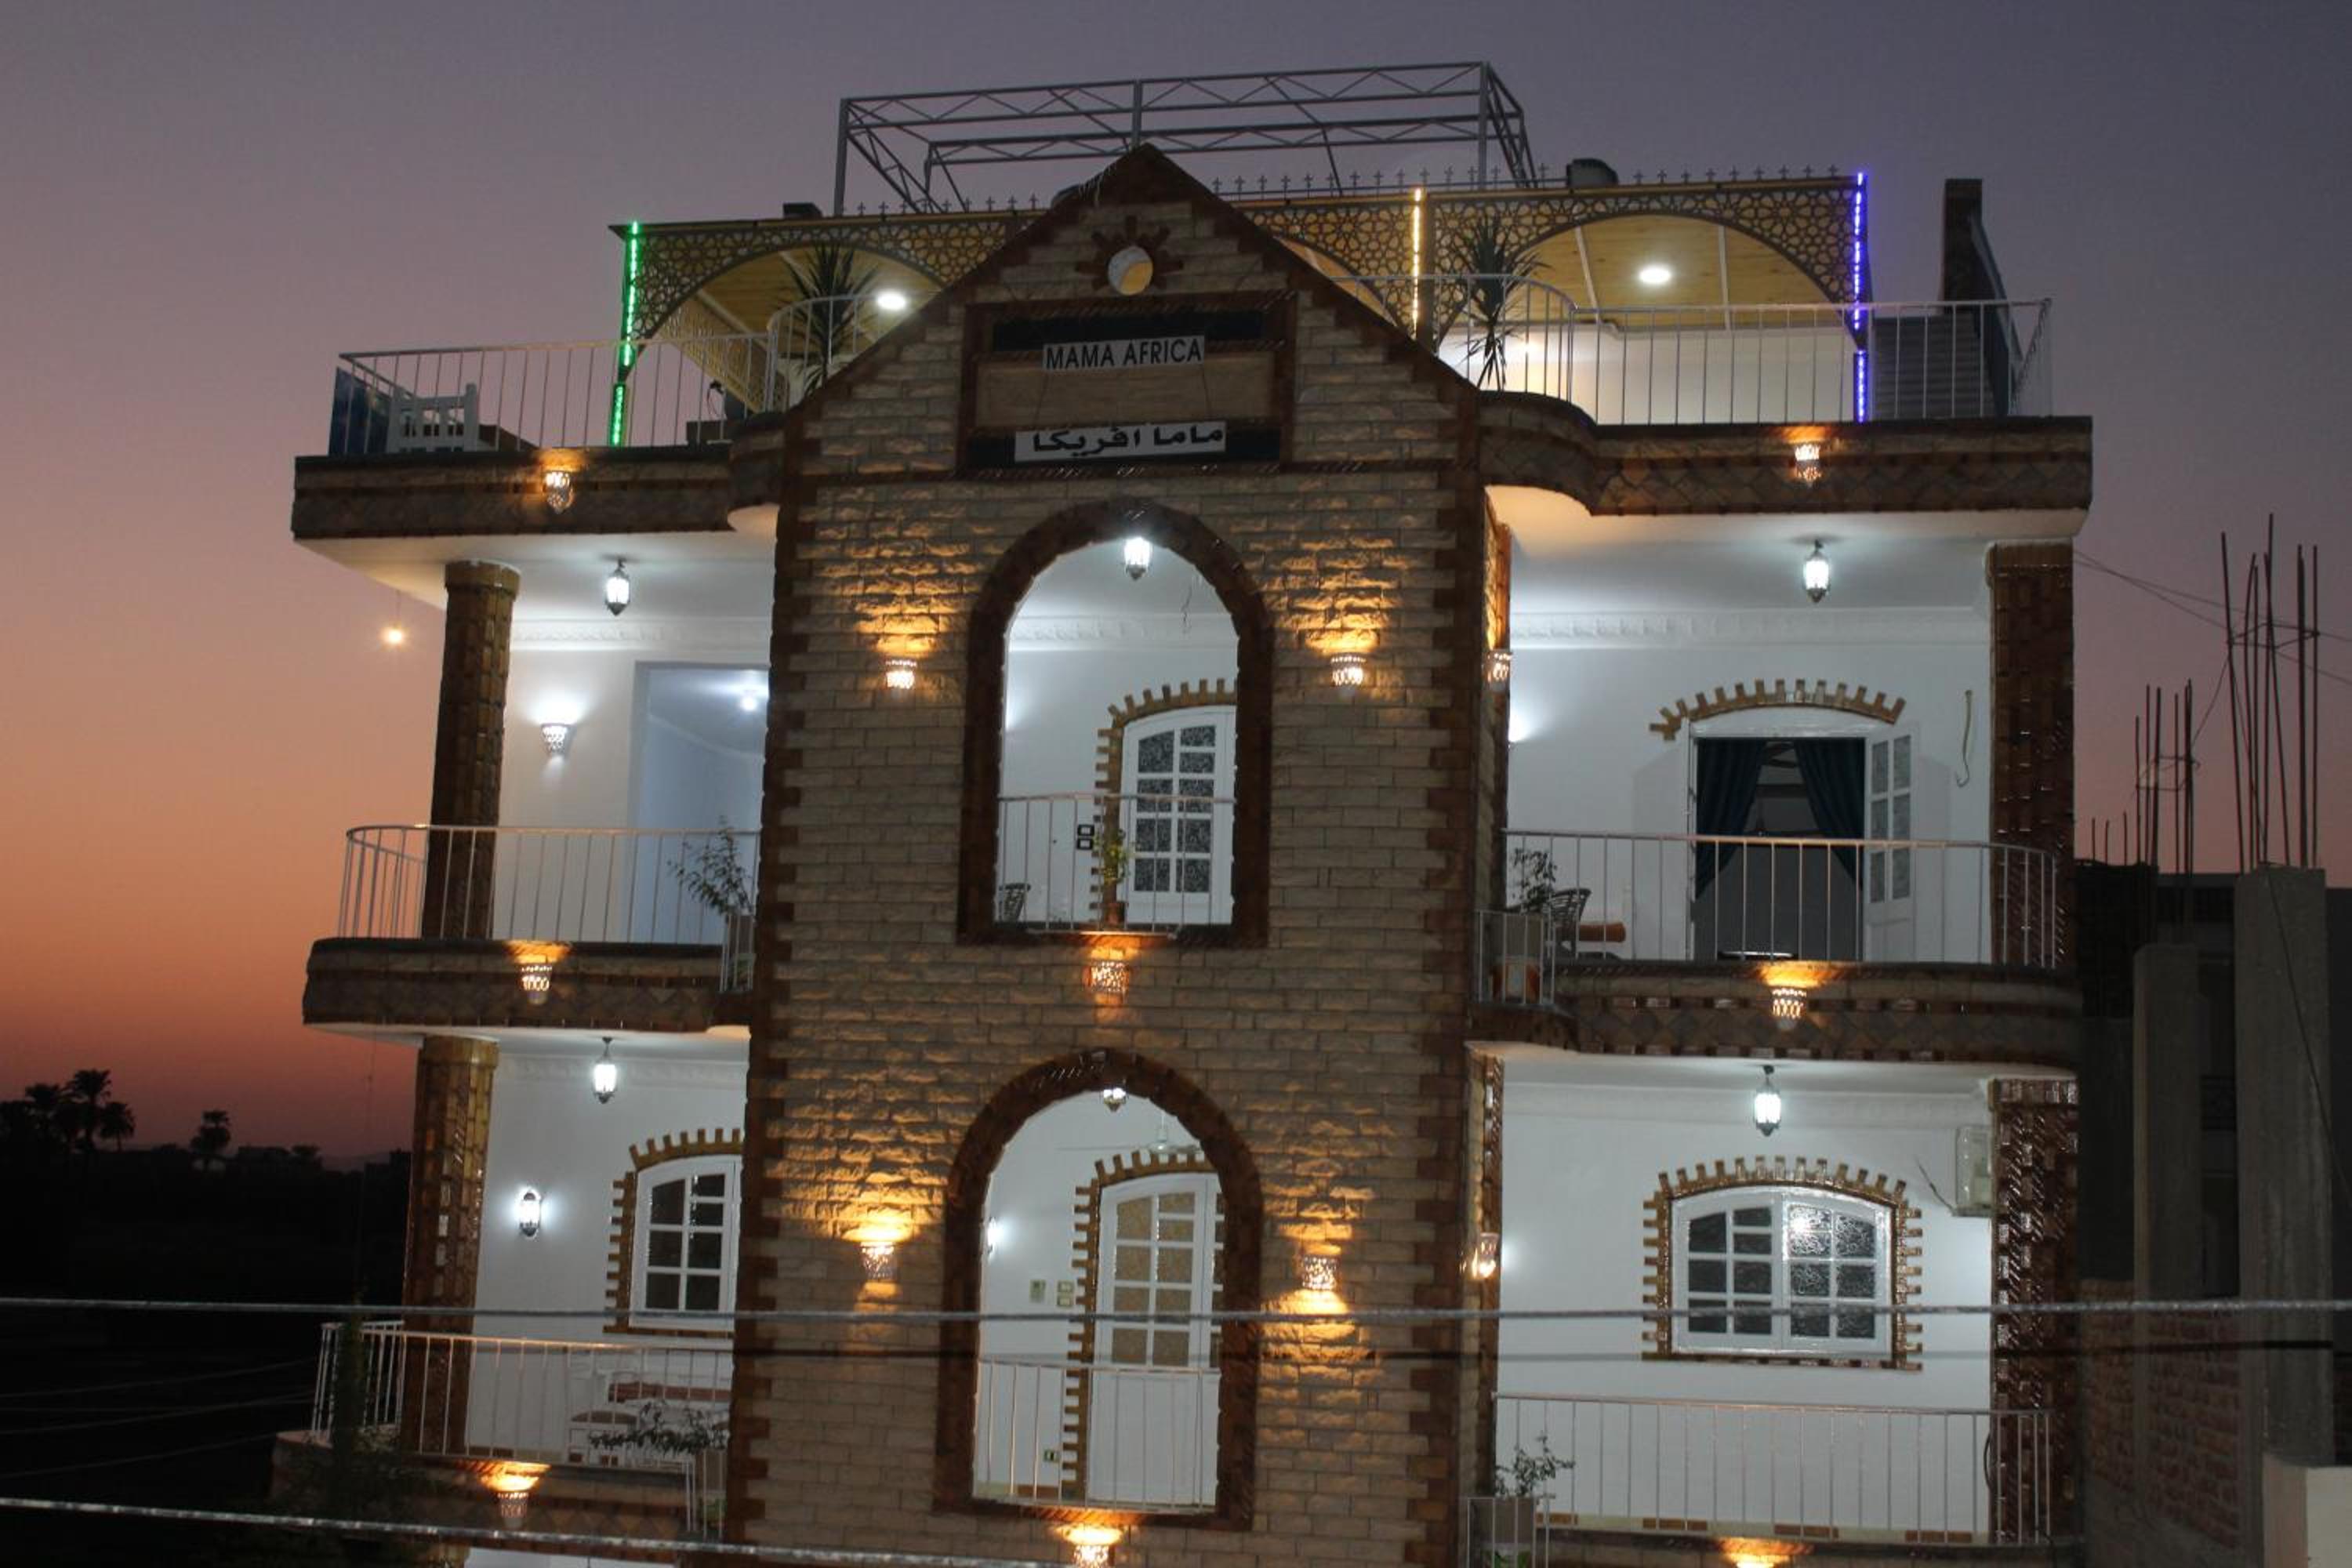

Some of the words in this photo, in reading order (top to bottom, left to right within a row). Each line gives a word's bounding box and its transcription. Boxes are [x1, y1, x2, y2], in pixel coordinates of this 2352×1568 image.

[1046, 345, 1114, 369] MAMA
[1123, 339, 1202, 365] AFRICA
[1153, 426, 1223, 445] ماما
